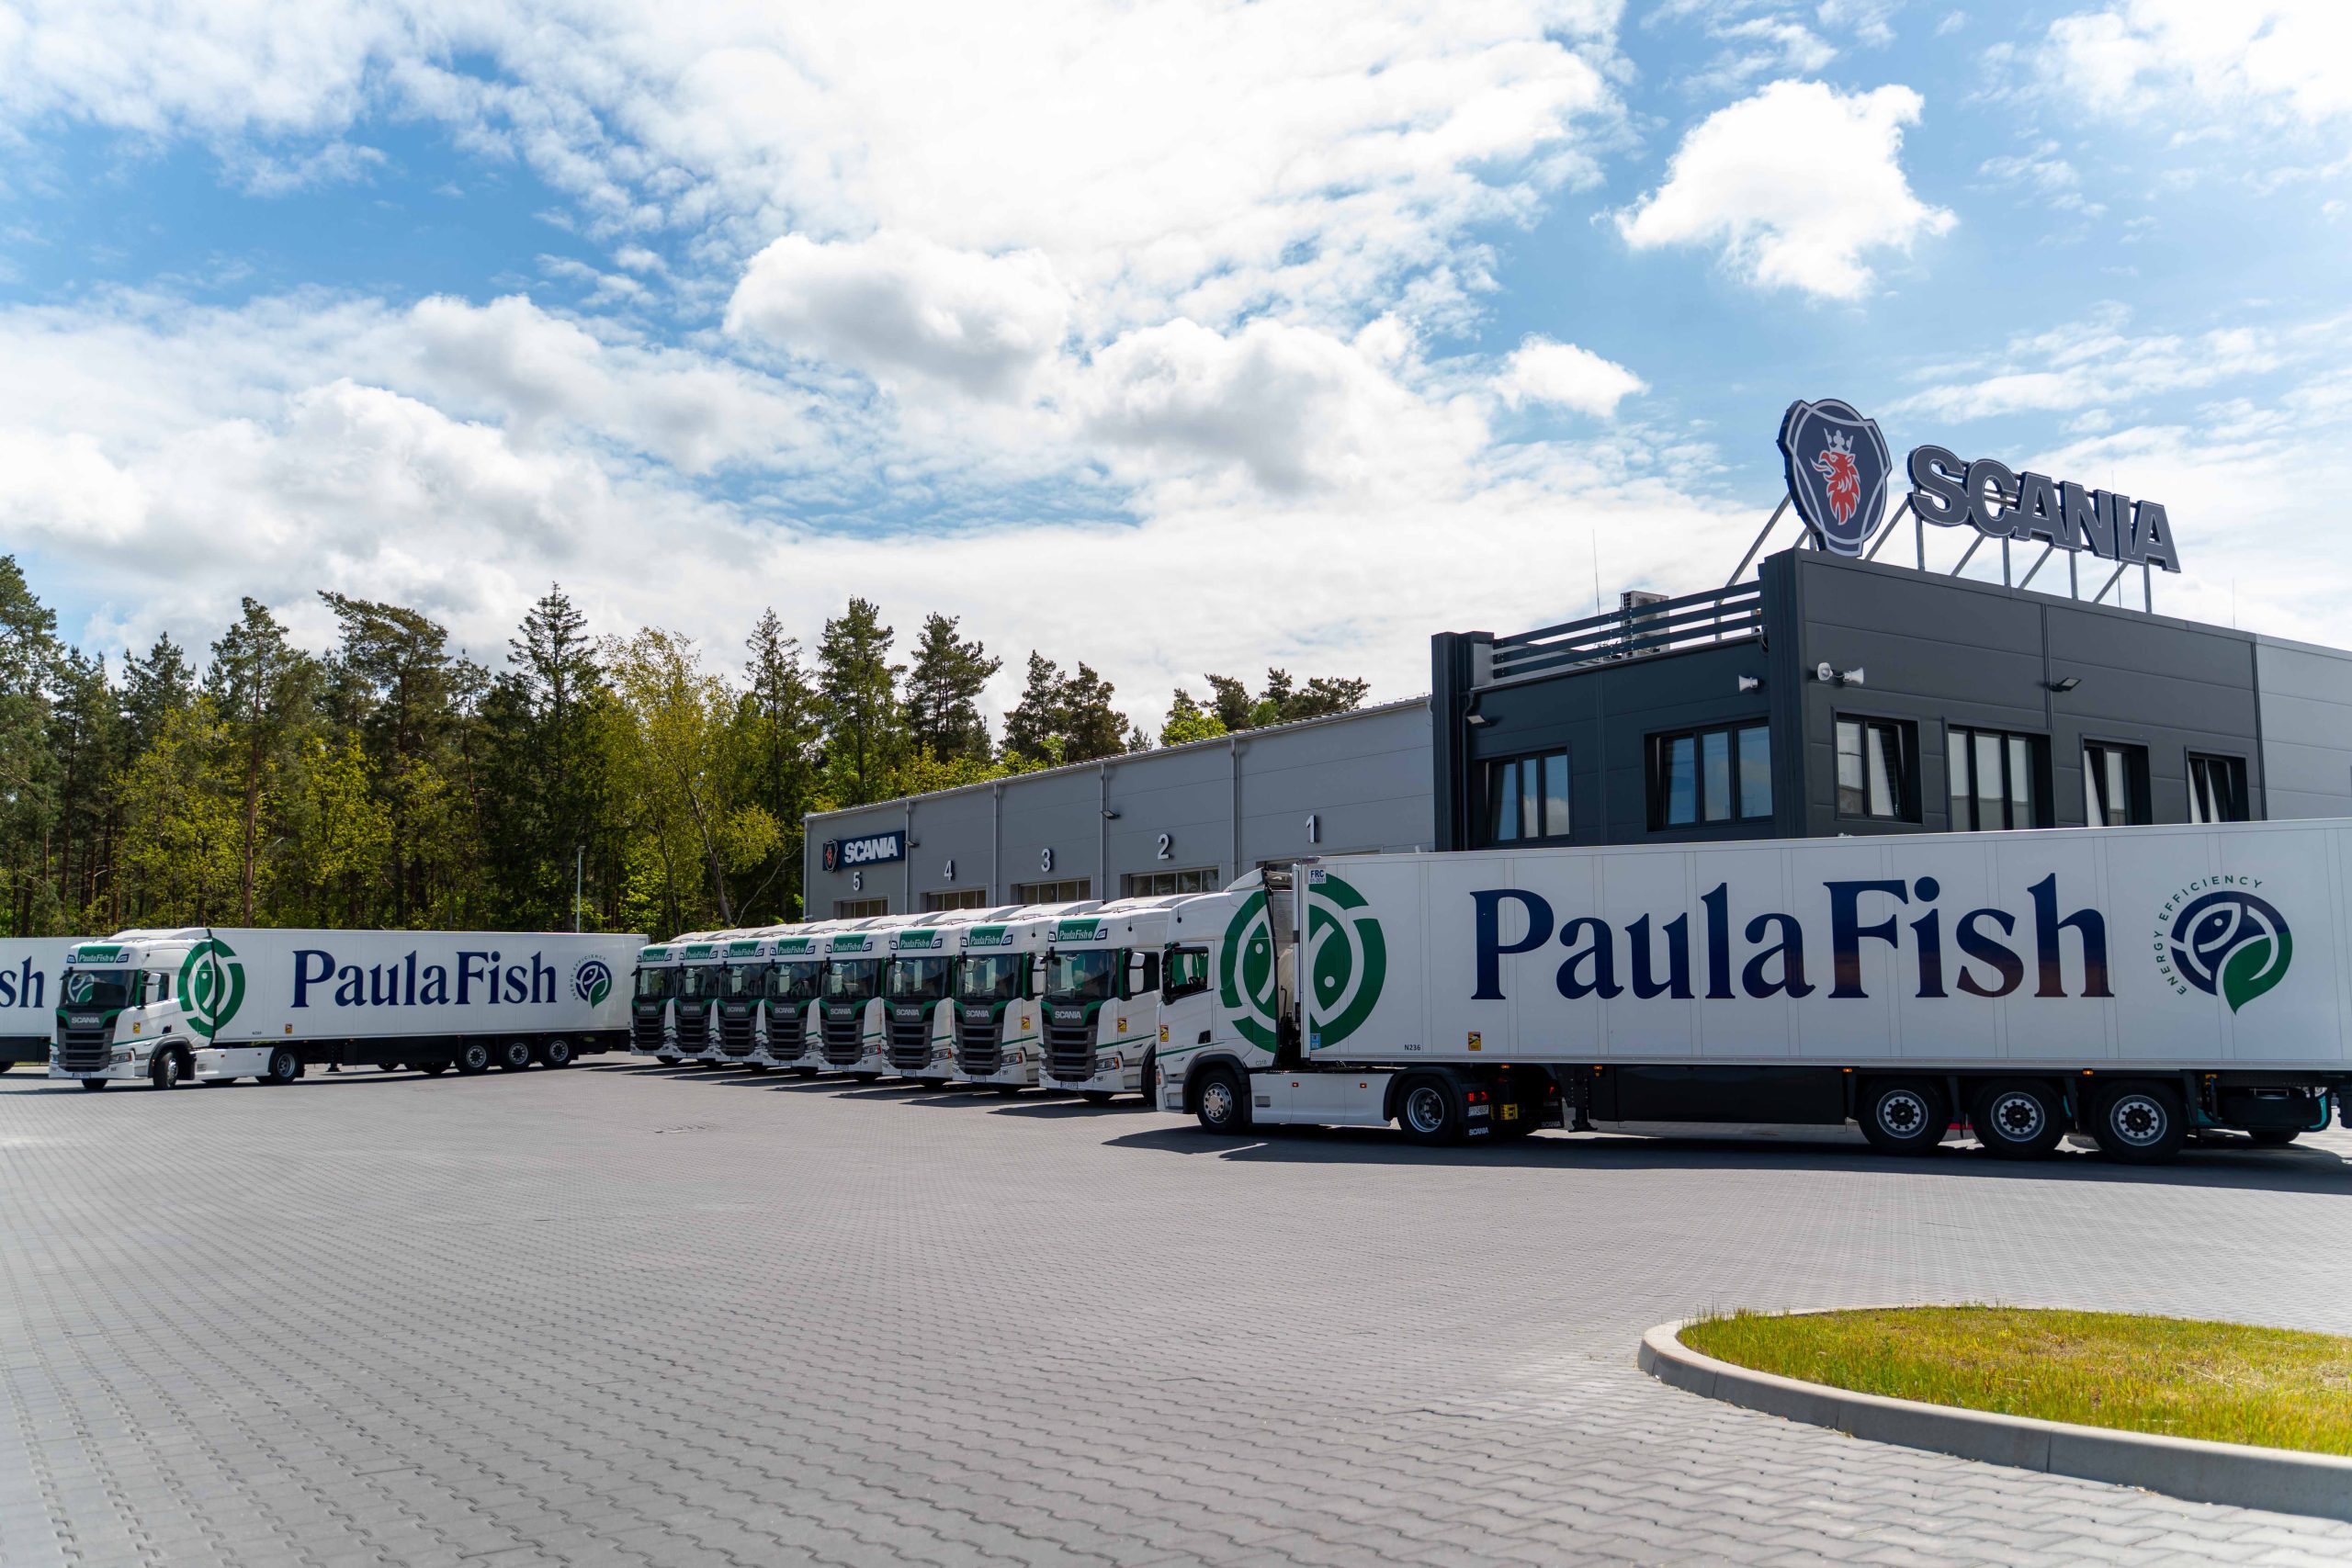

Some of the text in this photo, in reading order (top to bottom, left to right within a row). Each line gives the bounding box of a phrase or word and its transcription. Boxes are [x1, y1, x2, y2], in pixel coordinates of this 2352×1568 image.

[1907, 445, 2181, 573] SCANIA
[1306, 815, 1317, 843] 1
[844, 834, 898, 863] SCANIA
[1158, 833, 1171, 860] 2
[944, 860, 955, 880] 4
[1041, 848, 1052, 872] 3
[853, 871, 861, 890] 5
[1310, 869, 1324, 878] FRC
[1058, 930, 1088, 940] PaulaFish
[1470, 873, 2115, 1000] PaulaFish
[2154, 875, 2262, 995] ENERGY EFFICIENCY
[291, 950, 559, 1008] PaulaFish
[966, 1010, 989, 1018] SCANIA
[1055, 1010, 1081, 1019] SCANIA
[1469, 1126, 1488, 1136] SCANIA
